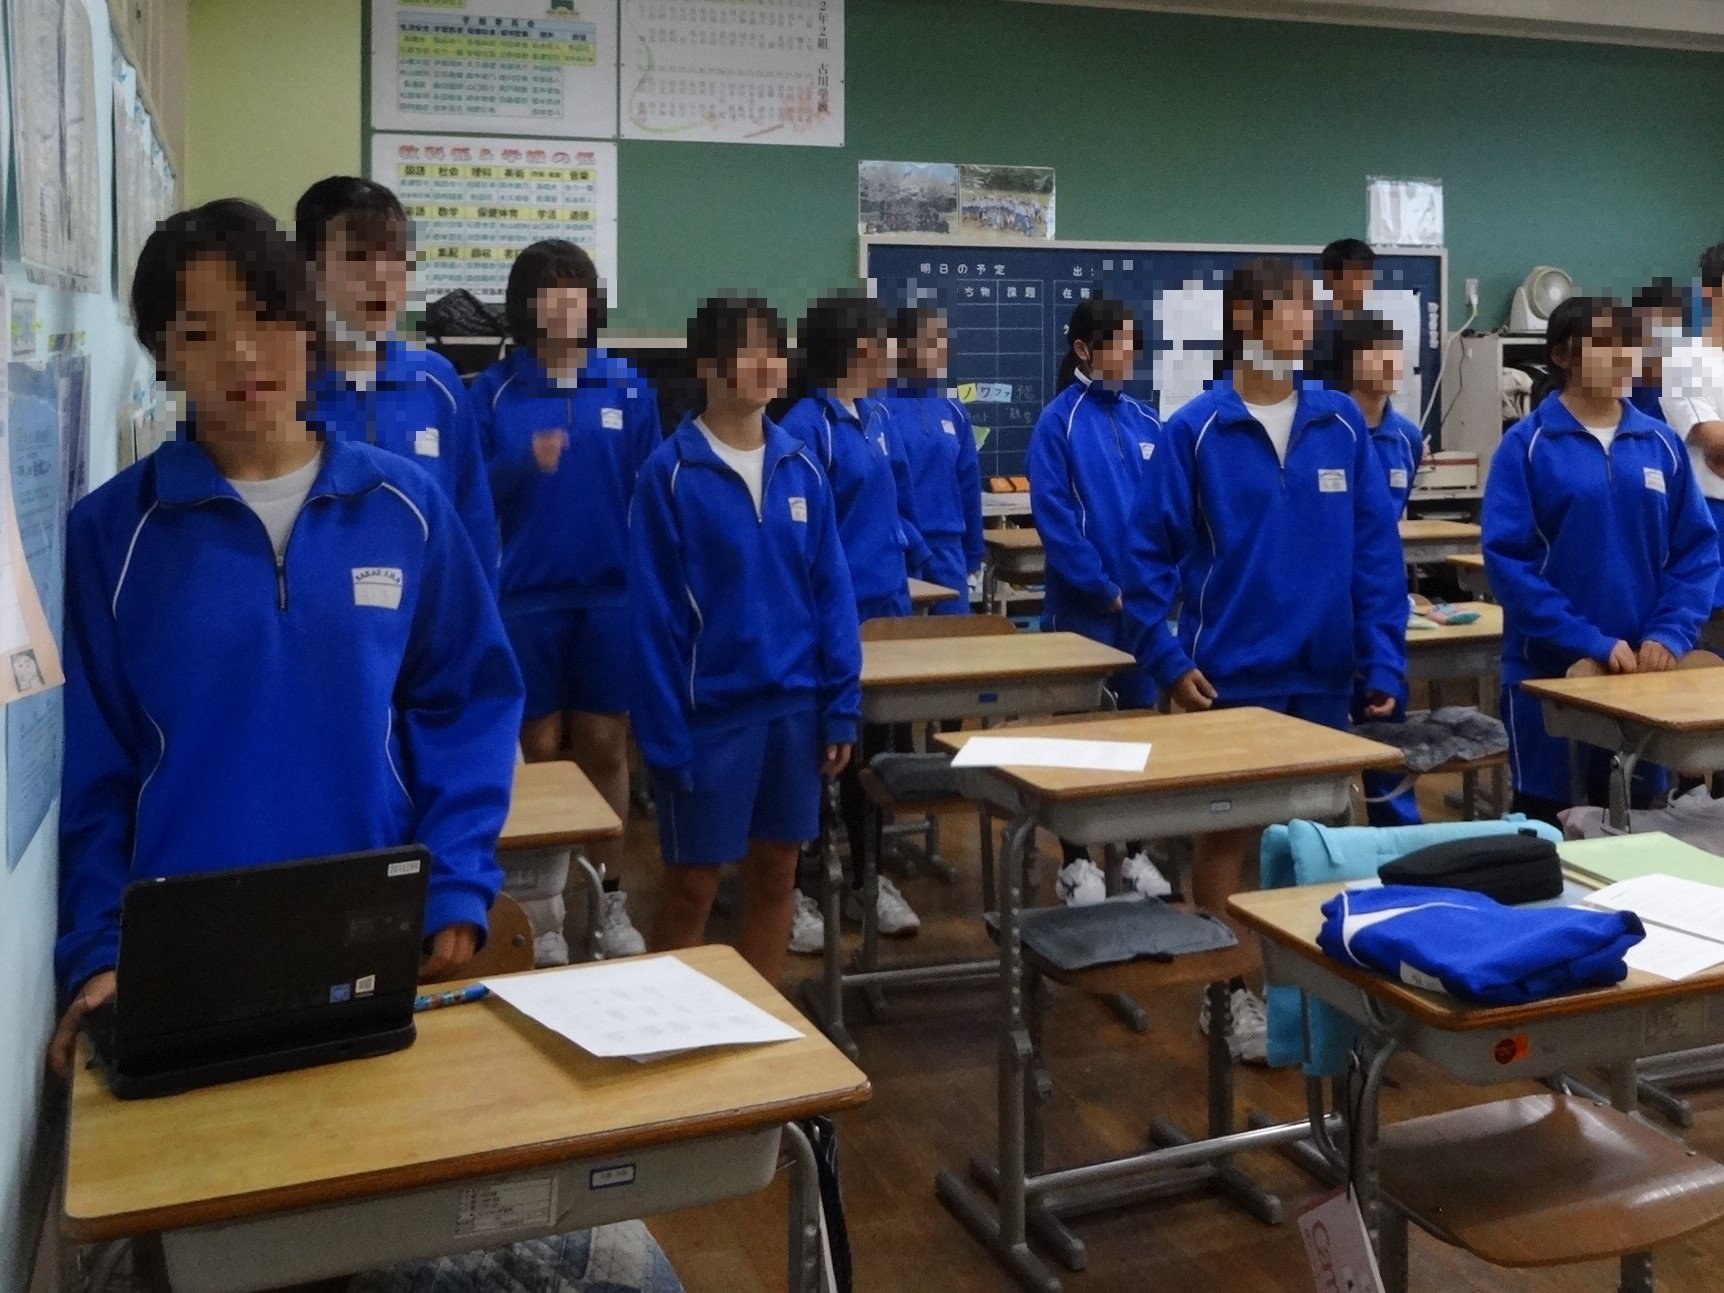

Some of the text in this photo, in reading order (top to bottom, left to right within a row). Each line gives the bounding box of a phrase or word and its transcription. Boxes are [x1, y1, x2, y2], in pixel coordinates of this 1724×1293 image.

[920, 262, 1006, 276] 明日の予定
[1006, 286, 1036, 298] 課題
